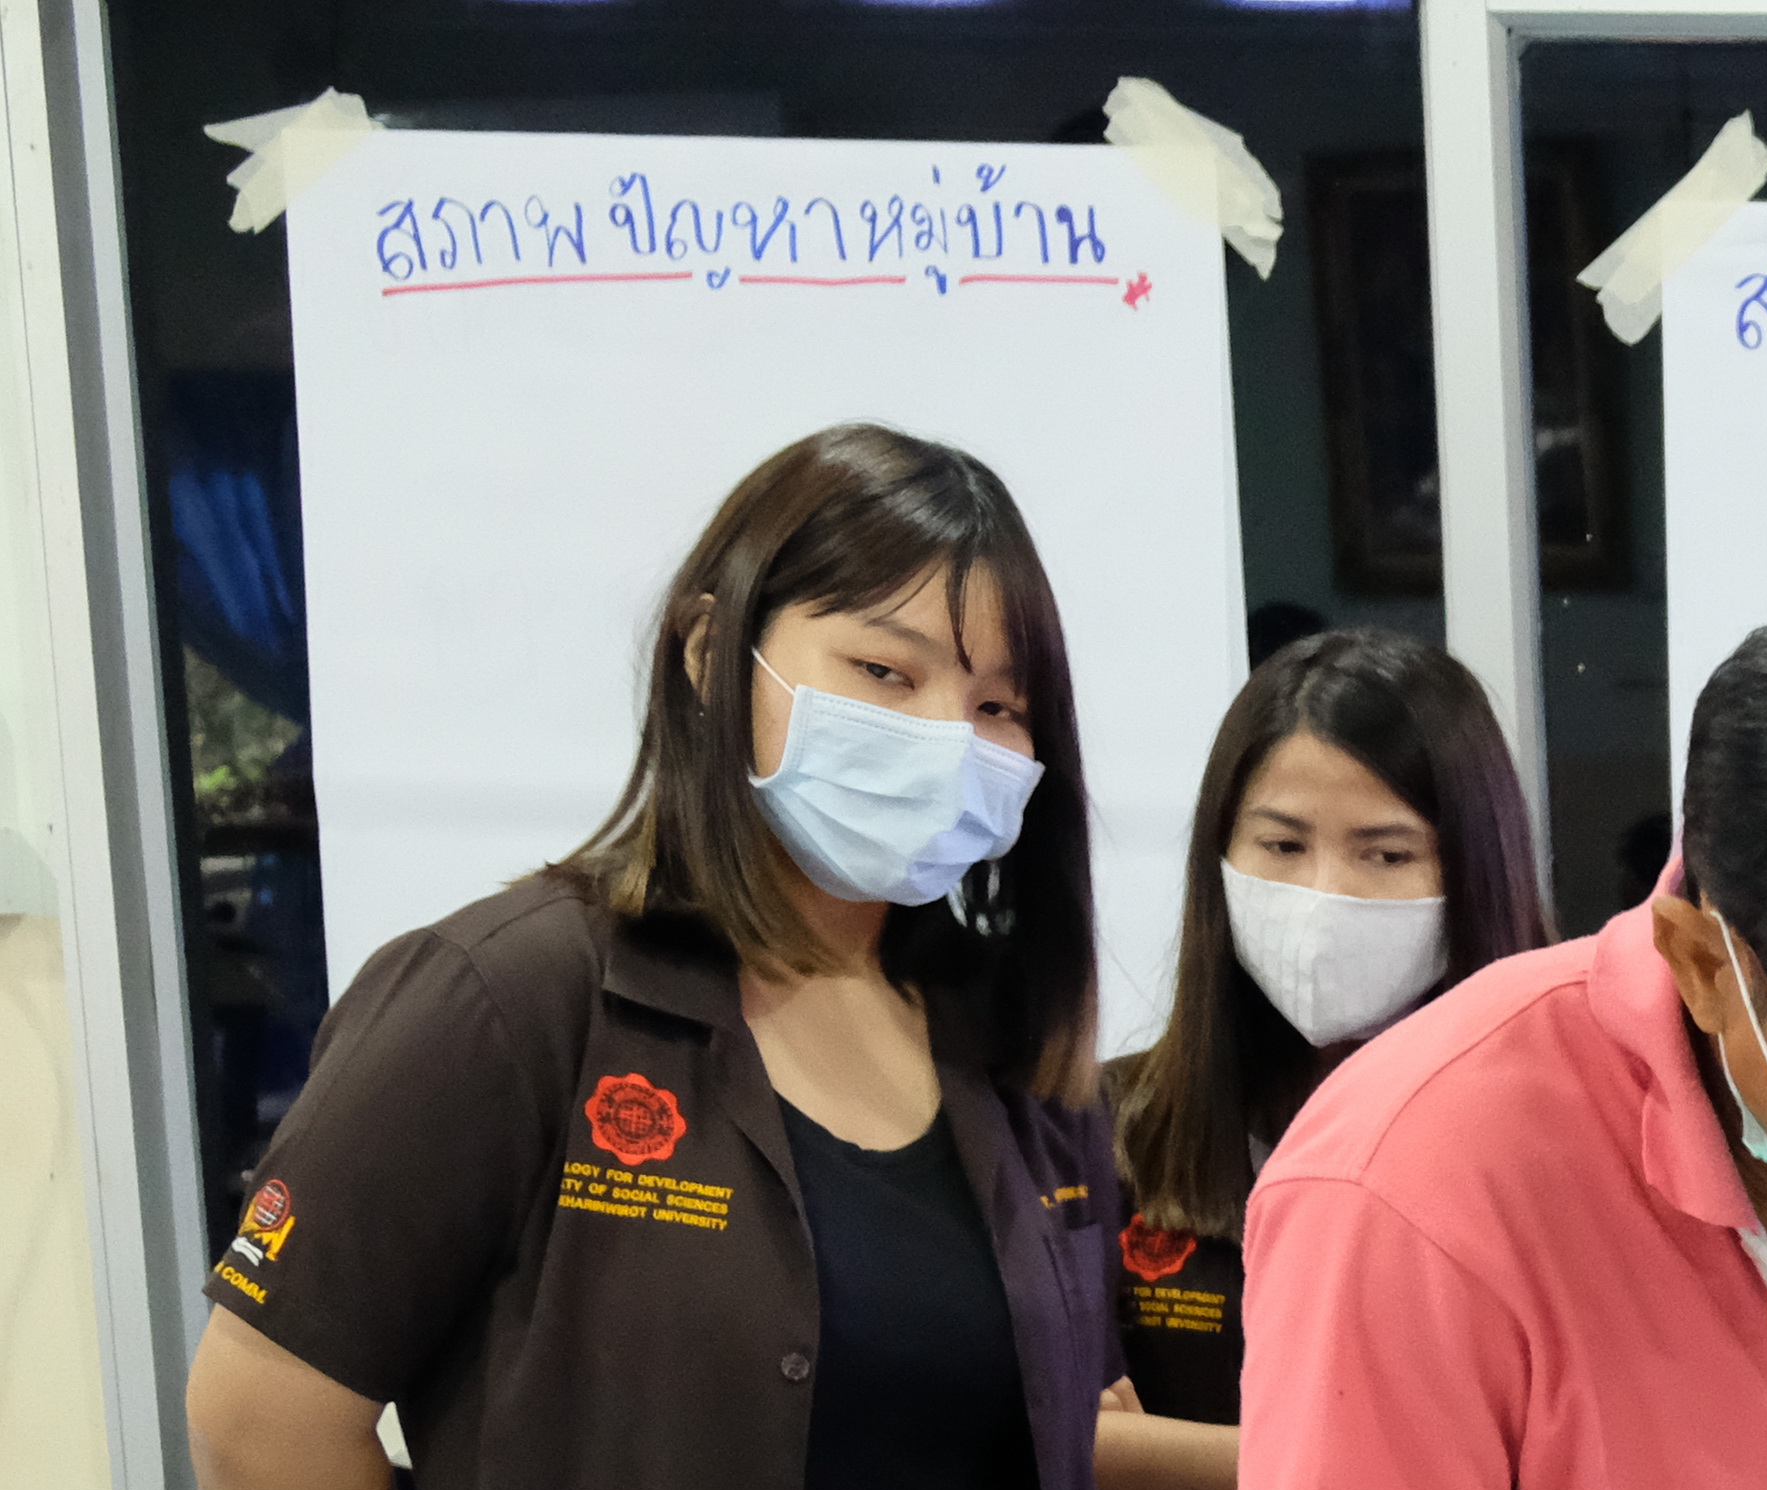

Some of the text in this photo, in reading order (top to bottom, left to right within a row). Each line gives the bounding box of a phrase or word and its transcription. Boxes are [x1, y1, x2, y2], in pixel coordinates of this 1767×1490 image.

[588, 1182, 606, 1196] OF
[612, 1186, 660, 1204] SOCIAL
[666, 1194, 729, 1215] SCIENCES
[606, 1168, 633, 1184] FOR
[638, 1174, 733, 1200] DEVELOPMENT
[653, 1207, 729, 1231] UNIVERSITY
